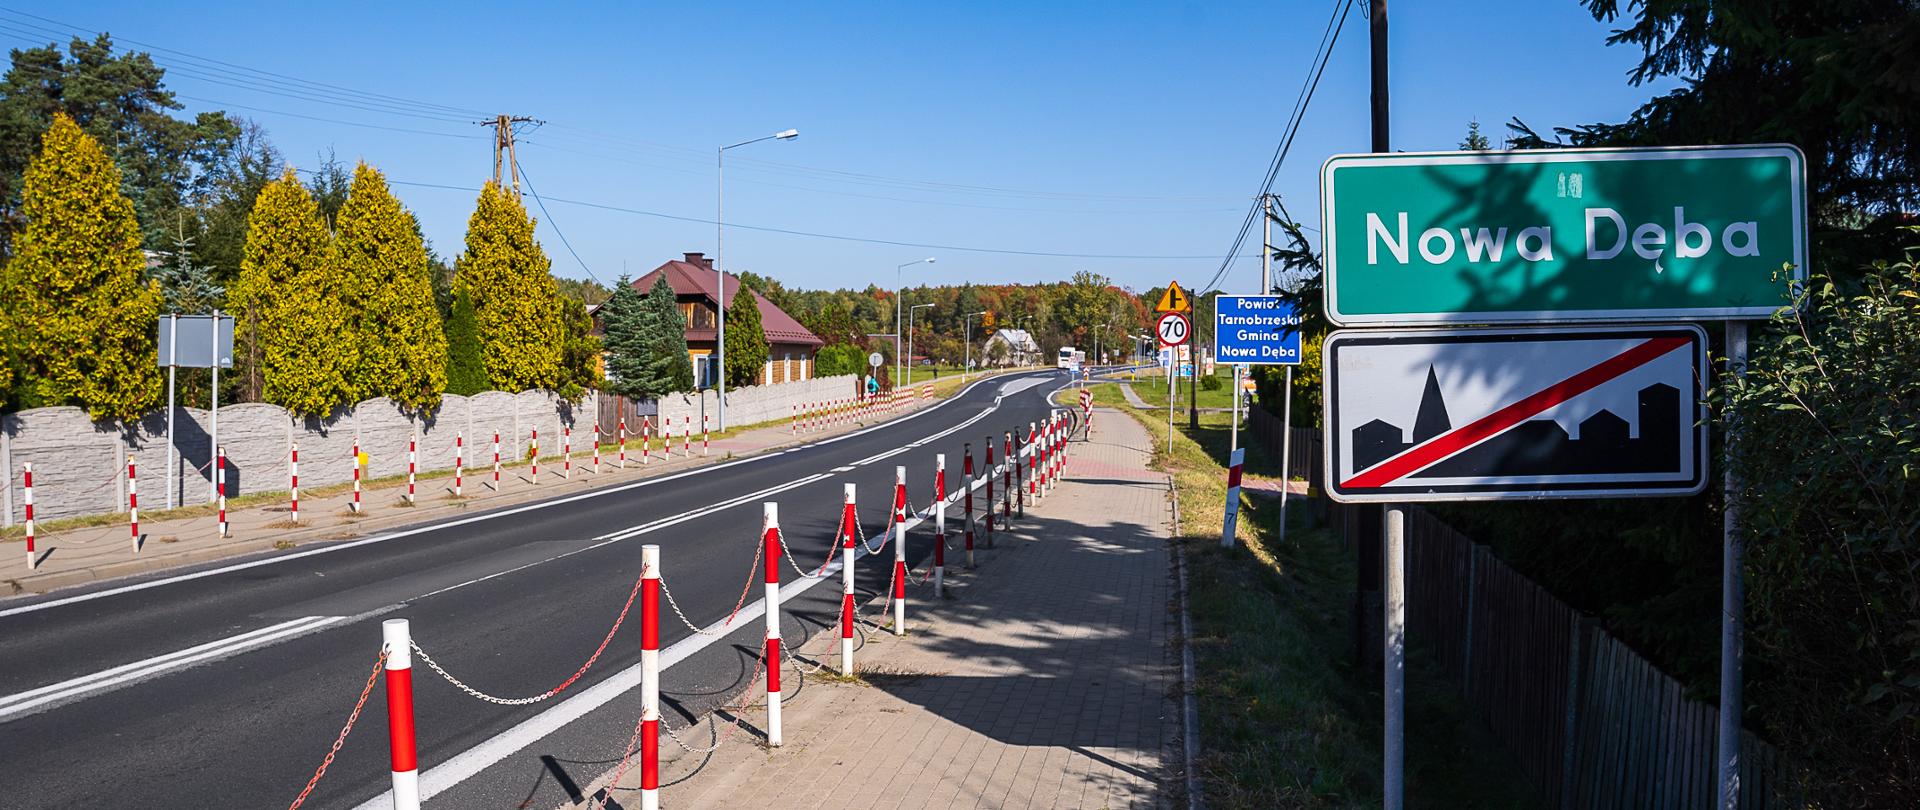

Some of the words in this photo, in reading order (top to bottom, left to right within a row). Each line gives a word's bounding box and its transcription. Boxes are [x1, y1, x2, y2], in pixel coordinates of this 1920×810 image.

[1365, 211, 1553, 265] Nowa
[1585, 206, 1760, 274] Dęba
[1218, 313, 1298, 325] Tarnobrzeski
[1163, 321, 1185, 338] 70
[1237, 329, 1279, 341] Gmina
[1221, 345, 1257, 357] Nowa
[1262, 345, 1296, 359] Dęba
[1227, 512, 1235, 524] 7
